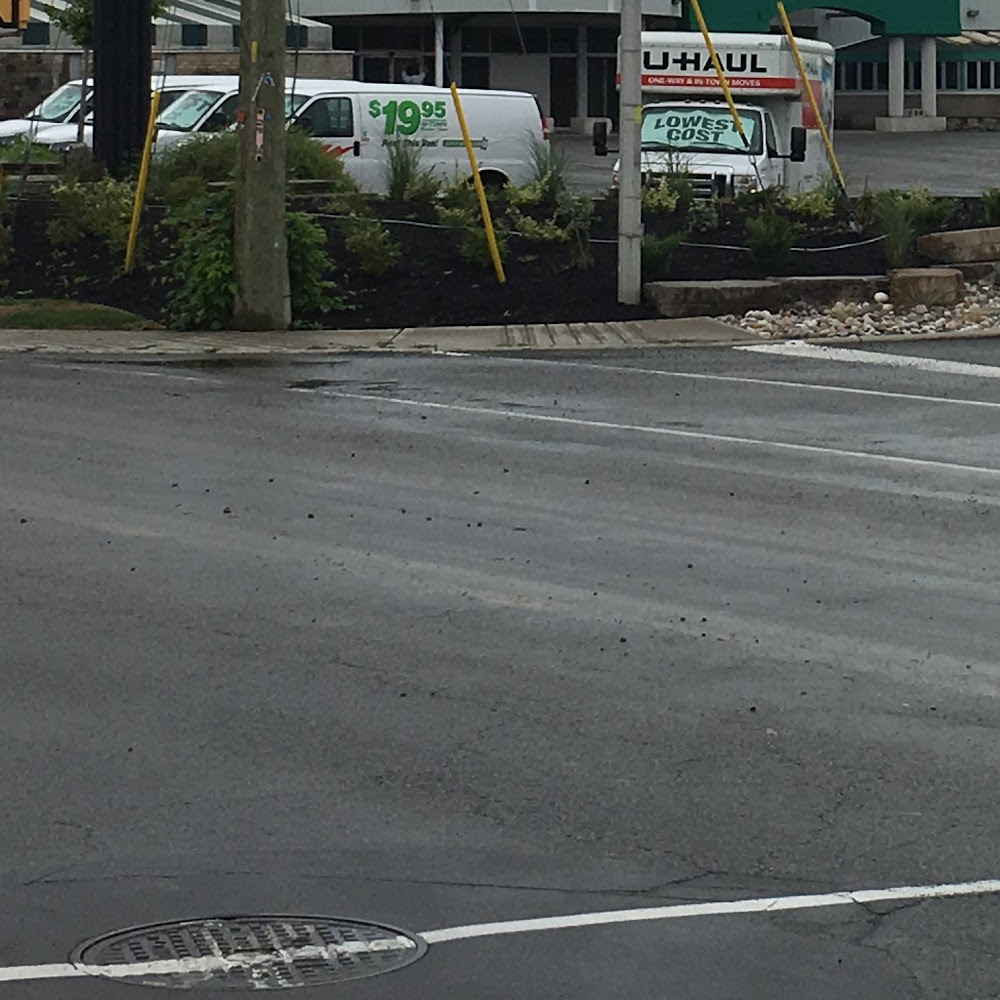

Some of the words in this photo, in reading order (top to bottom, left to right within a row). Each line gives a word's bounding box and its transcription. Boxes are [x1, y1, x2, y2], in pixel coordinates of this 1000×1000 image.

[643, 51, 767, 73] U-HAUL
[648, 77, 685, 85] ONE-WAY
[731, 79, 761, 87] MOVES
[654, 115, 743, 133] LOWEST
[666, 128, 725, 143] COST
